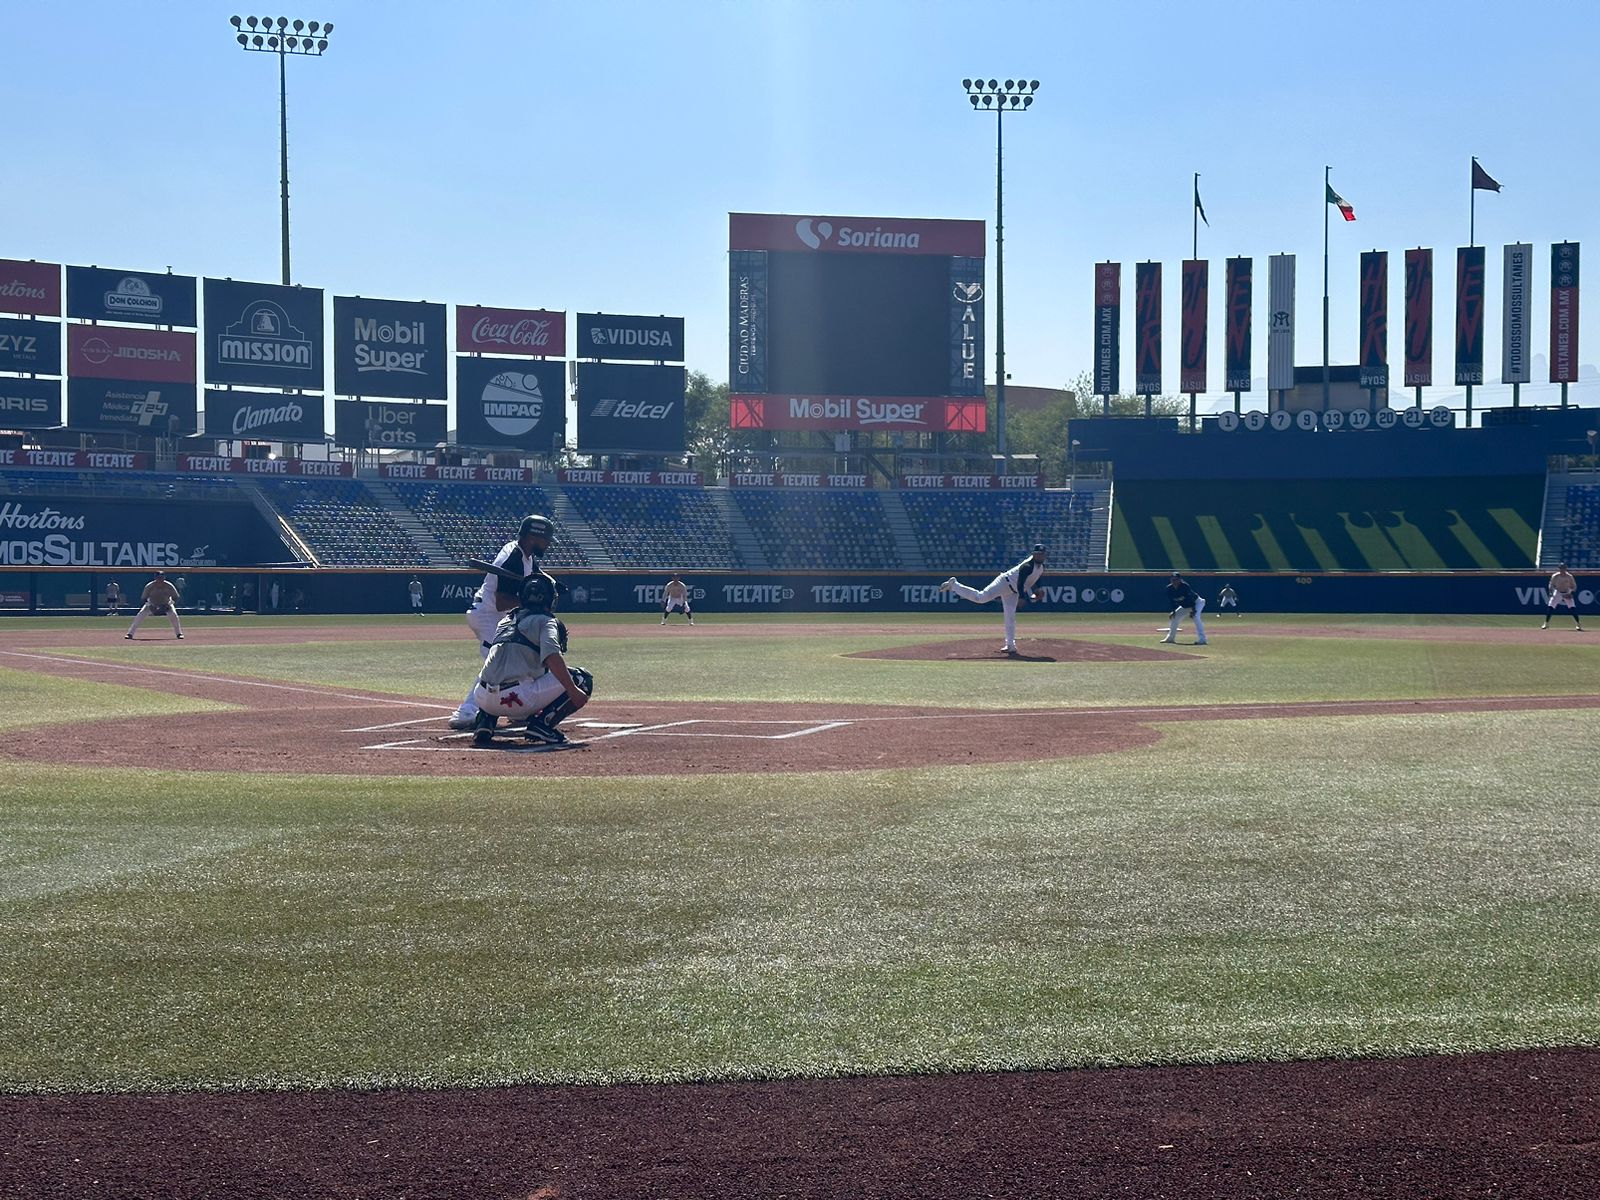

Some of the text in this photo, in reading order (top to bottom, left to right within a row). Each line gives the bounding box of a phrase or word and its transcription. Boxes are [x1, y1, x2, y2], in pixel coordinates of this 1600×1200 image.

[838, 227, 920, 248] Soriana
[0, 280, 46, 300] rtons
[354, 317, 425, 345] Mobil
[472, 316, 552, 346] Coca-Cola
[739, 276, 750, 374] CIUDAD MADERAS
[607, 328, 673, 347] VIDUSA
[1558, 290, 1570, 380] SULTANES.COM.MX
[113, 346, 182, 362] JIDOSHA
[354, 343, 425, 372] Super
[1101, 307, 1112, 392] SULTANES.COM.MX
[1227, 379, 1250, 389] ANES
[232, 401, 303, 435] Clamato
[368, 405, 416, 424] Uber
[483, 402, 541, 417] IMPAC
[613, 400, 675, 419] telcel
[789, 398, 925, 424] Mobil Super
[1380, 412, 1394, 424] 20
[1406, 411, 1420, 423] 21
[1432, 410, 1448, 422] 22
[1224, 415, 1232, 427] 1
[1251, 414, 1258, 426] 5
[1277, 414, 1285, 426] 7
[1303, 414, 1311, 426] 9
[1326, 413, 1340, 425] 13
[1353, 413, 1367, 425] 17
[26, 450, 76, 466] TECATE
[86, 452, 136, 468] TECATE
[186, 456, 342, 476] TECATE TECATE TECATE
[385, 465, 525, 481] TECATE TECATE TECATE
[564, 469, 697, 485] TECATE TECATE TECATE
[735, 473, 867, 487] TECATE TECATE TECATE
[904, 475, 1039, 488] TECATE TECATE TECATE
[0, 502, 85, 530] Hortons
[633, 585, 695, 603] TECE
[722, 584, 783, 603] TECATE
[810, 585, 872, 603] TECATE
[1040, 585, 1077, 603] iva
